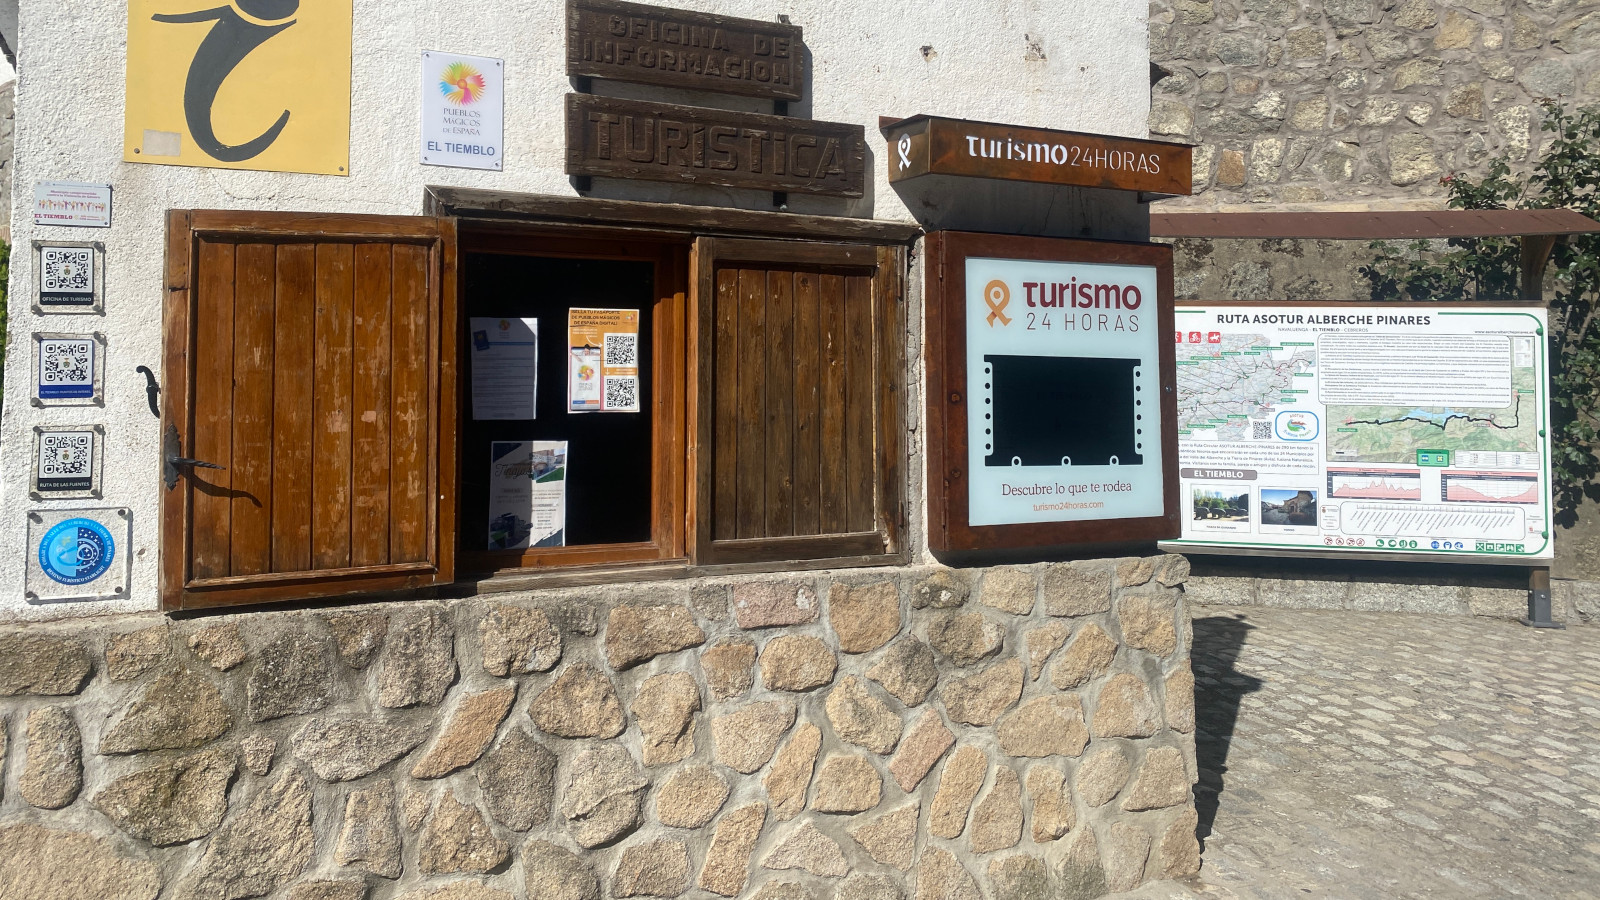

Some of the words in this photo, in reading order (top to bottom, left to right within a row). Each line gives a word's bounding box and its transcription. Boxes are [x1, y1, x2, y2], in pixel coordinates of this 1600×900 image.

[608, 14, 730, 52] OFICINA
[753, 34, 791, 59] DE
[583, 38, 791, 86] INFORMACION
[444, 108, 480, 118] PUEBLOS
[443, 117, 480, 127] MÁGICOS
[452, 127, 480, 136] ESPAÑA
[428, 141, 442, 152] EL
[445, 142, 495, 156] TIEMBLO
[1023, 276, 1142, 310] turismo
[1026, 312, 1052, 331] 24
[1065, 313, 1140, 332] HORAS
[1217, 314, 1250, 324] RUTA
[1253, 315, 1303, 324] ASOTUR
[1307, 315, 1373, 325] ALBERCHE
[1377, 315, 1430, 325] PINARES
[1206, 471, 1244, 479] TIEMBLO
[1002, 484, 1052, 496] Descubre
[1056, 483, 1065, 494] lo
[1068, 484, 1088, 496] que
[1090, 482, 1100, 493] te
[1103, 481, 1132, 492] rodea
[1033, 501, 1104, 512] turismo24horas.com
